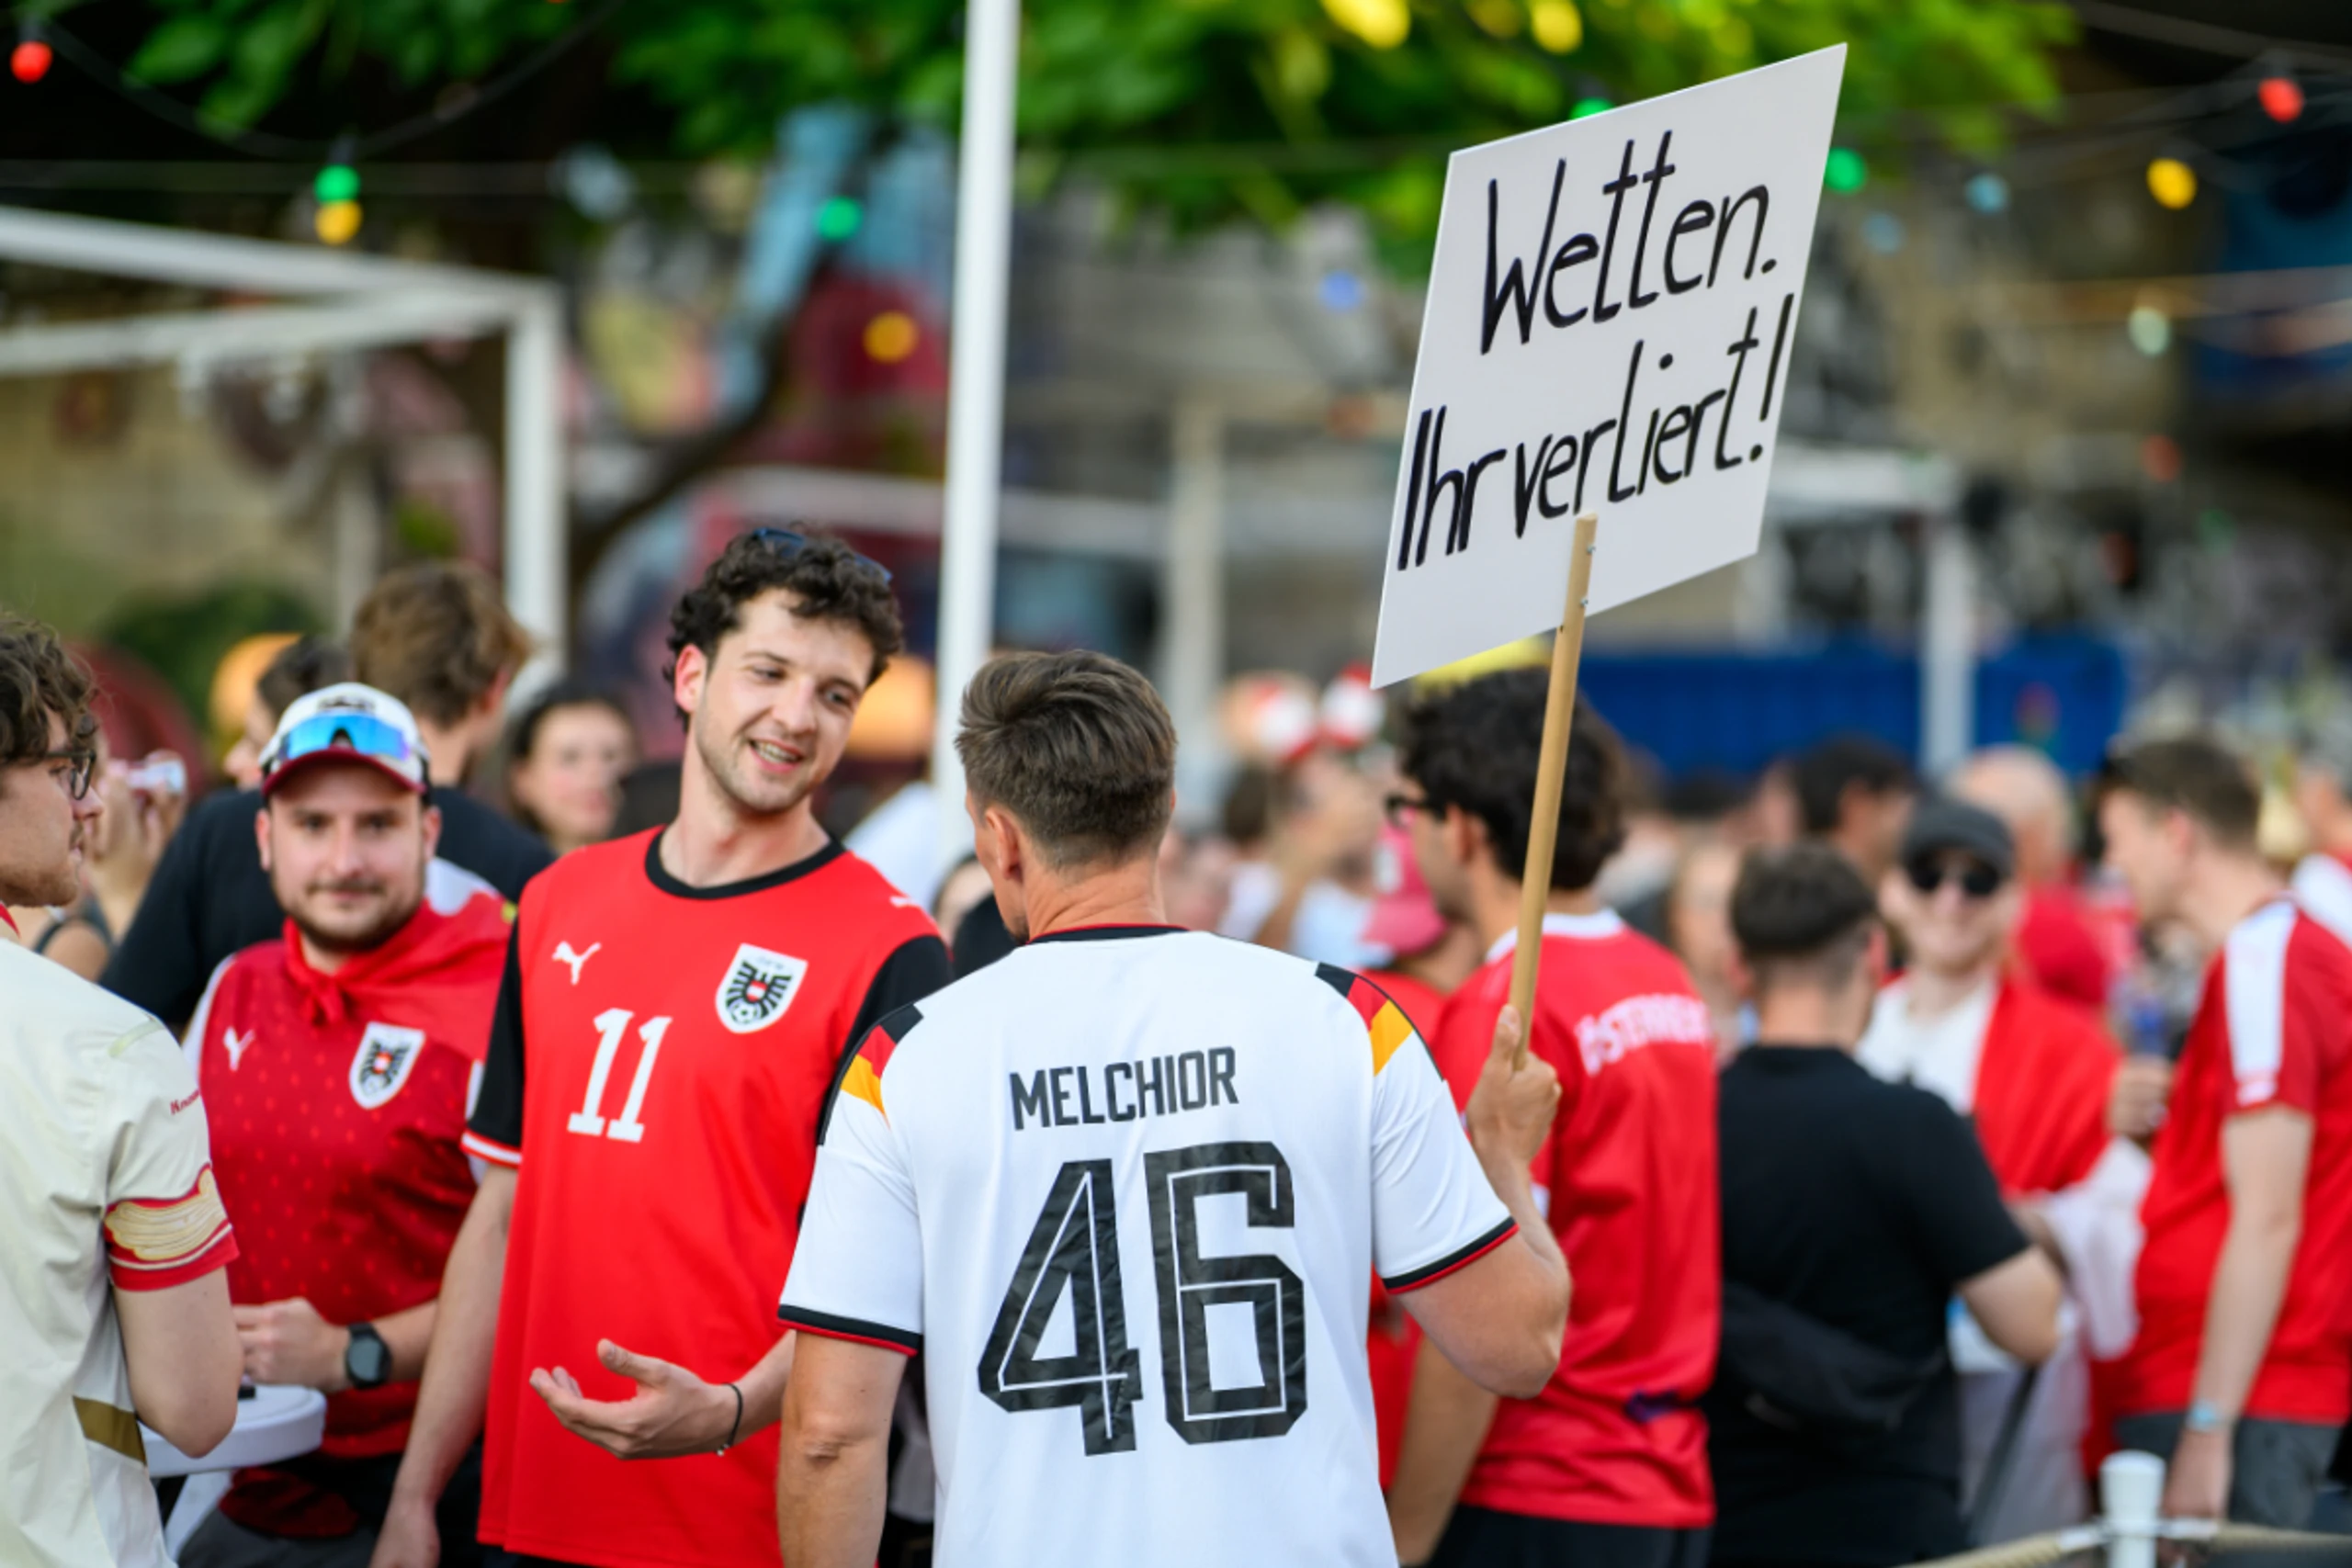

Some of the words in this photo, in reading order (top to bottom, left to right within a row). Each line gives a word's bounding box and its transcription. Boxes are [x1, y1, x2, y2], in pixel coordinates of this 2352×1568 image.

[1480, 130, 1777, 355] Wetten.
[1397, 404, 1508, 571] Ihr
[1514, 293, 1794, 539] verliert!
[567, 1008, 673, 1143] 11
[1010, 1047, 1238, 1131] MELCHIOR
[977, 1141, 1308, 1457] 46
